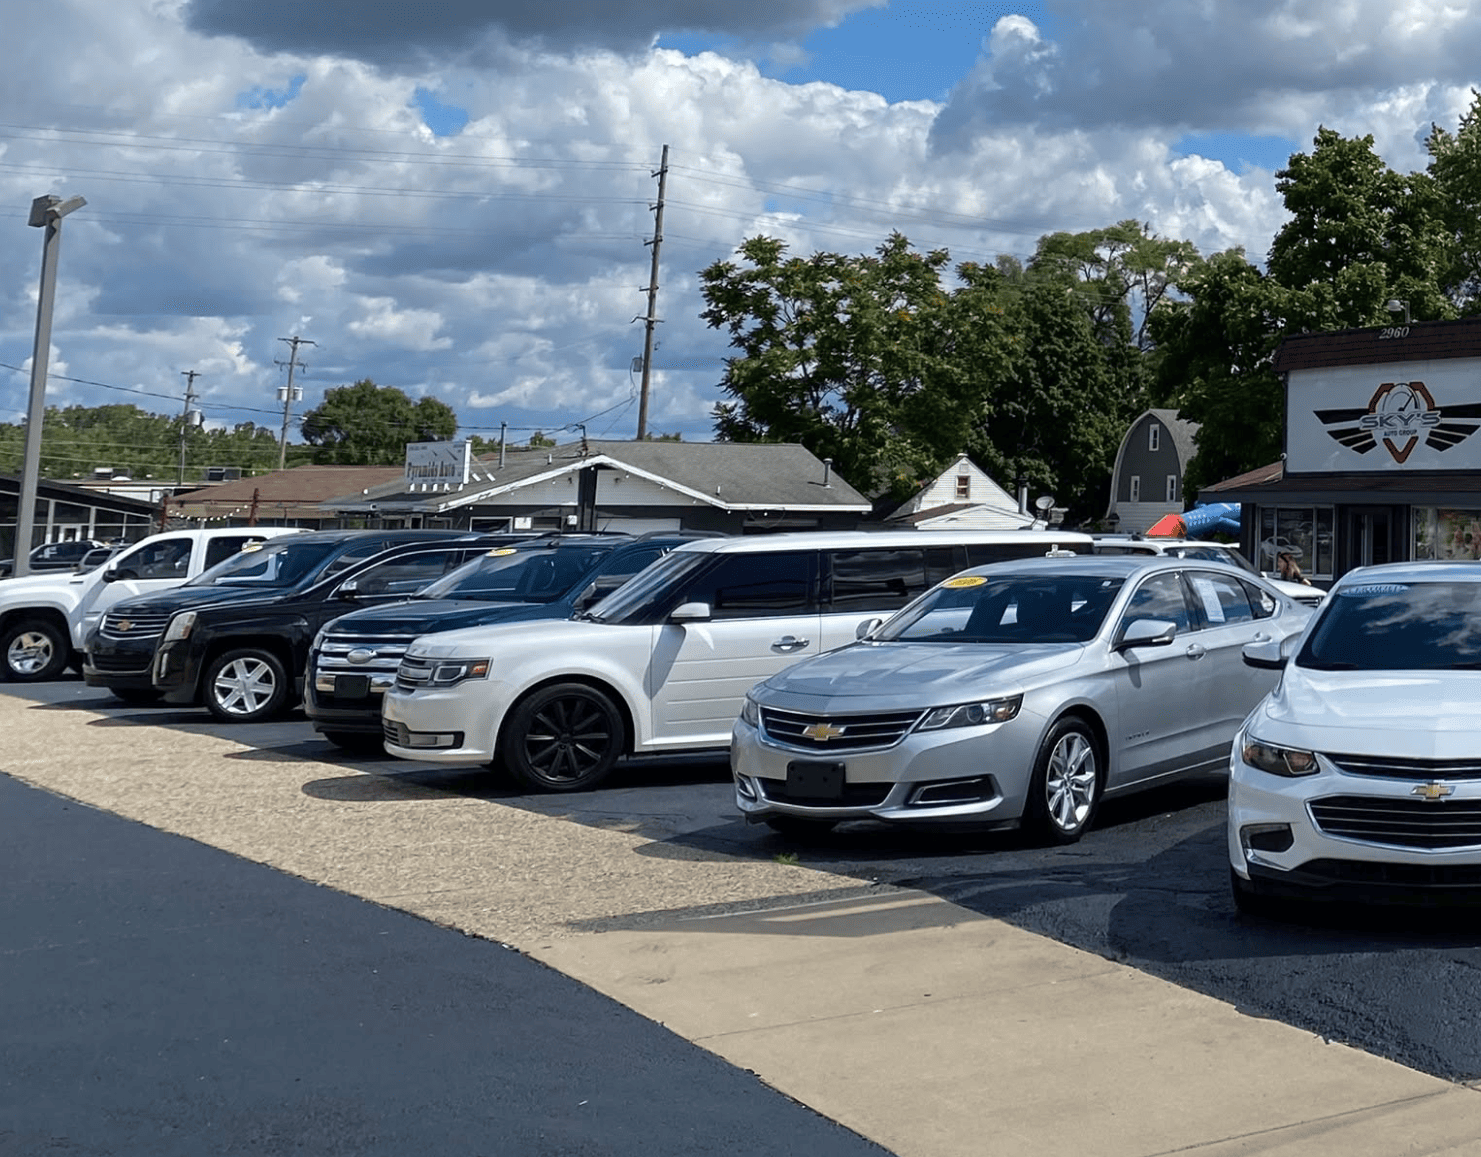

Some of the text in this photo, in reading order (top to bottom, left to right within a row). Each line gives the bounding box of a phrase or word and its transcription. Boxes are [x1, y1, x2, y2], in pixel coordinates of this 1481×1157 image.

[1379, 326, 1410, 339] 2960
[1360, 410, 1441, 430] SKY'S
[1399, 429, 1418, 437] GROUP
[407, 461, 456, 481] Pyramids Auto
